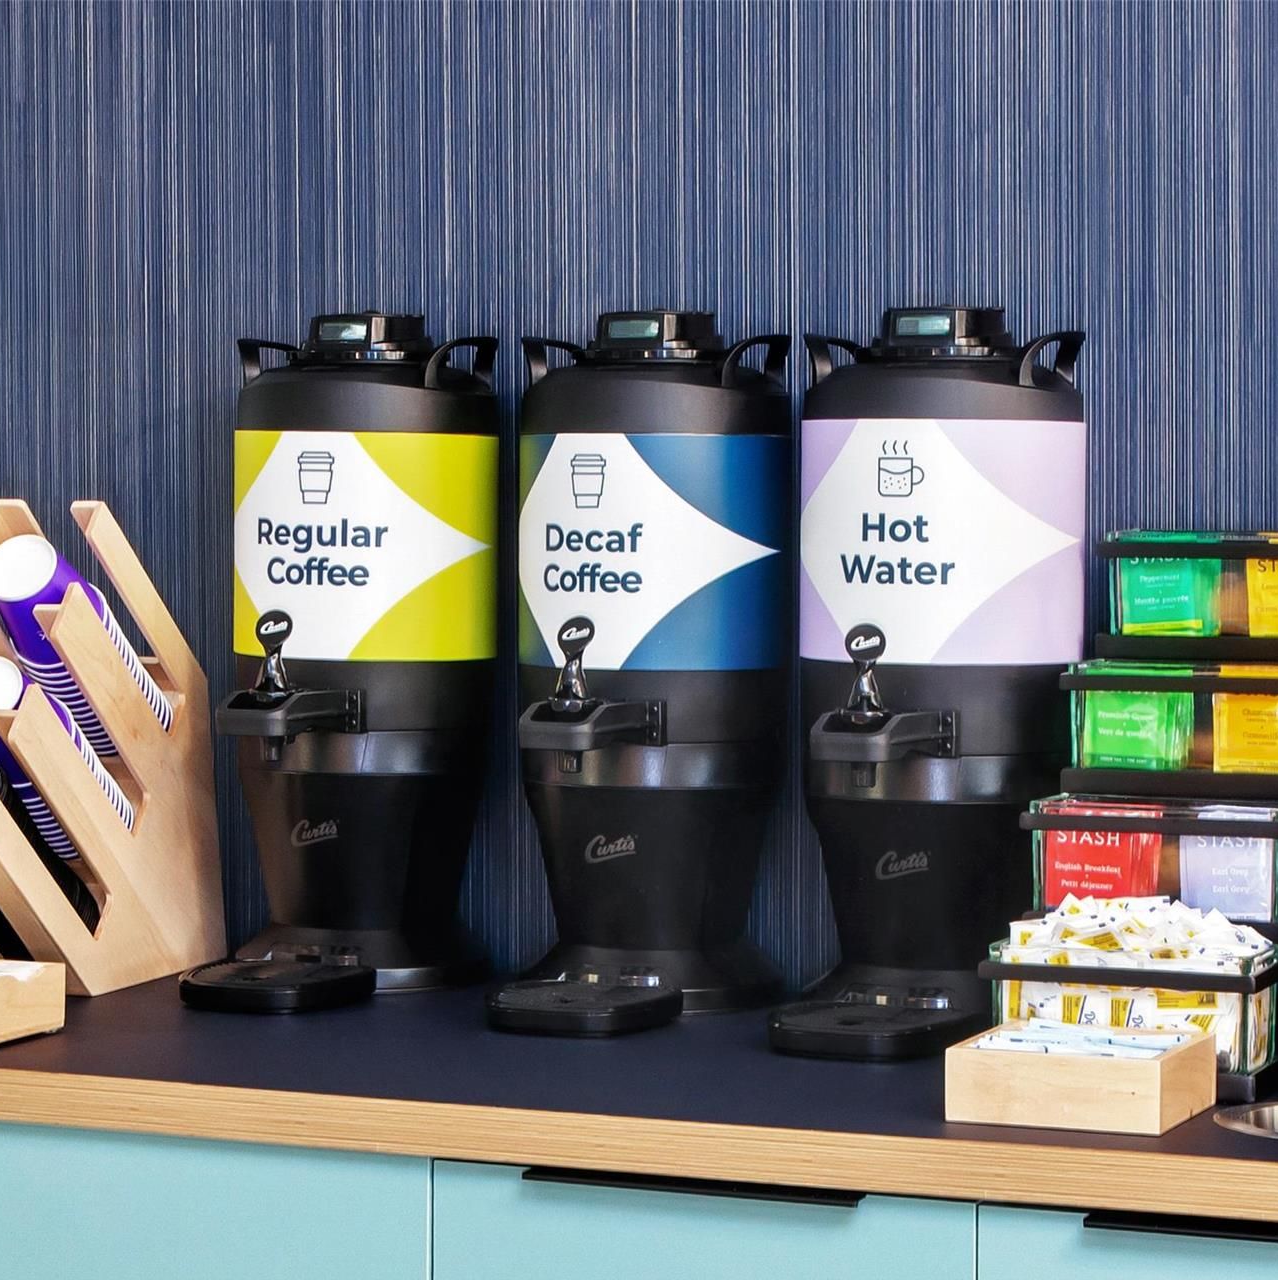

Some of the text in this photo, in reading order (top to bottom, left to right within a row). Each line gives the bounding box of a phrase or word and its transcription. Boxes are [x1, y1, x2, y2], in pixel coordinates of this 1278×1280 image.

[257, 517, 389, 553] Regular
[545, 522, 643, 552] Decaf
[861, 512, 929, 543] Hot
[267, 556, 370, 586] Coffee
[543, 562, 643, 594] Coffee
[840, 553, 955, 585] Water
[290, 819, 339, 848] Curtis
[585, 834, 637, 864] Curtis
[875, 850, 930, 880] Curtis
[1054, 861, 1121, 874] English Breakfast
[1060, 879, 1078, 888] Petit
